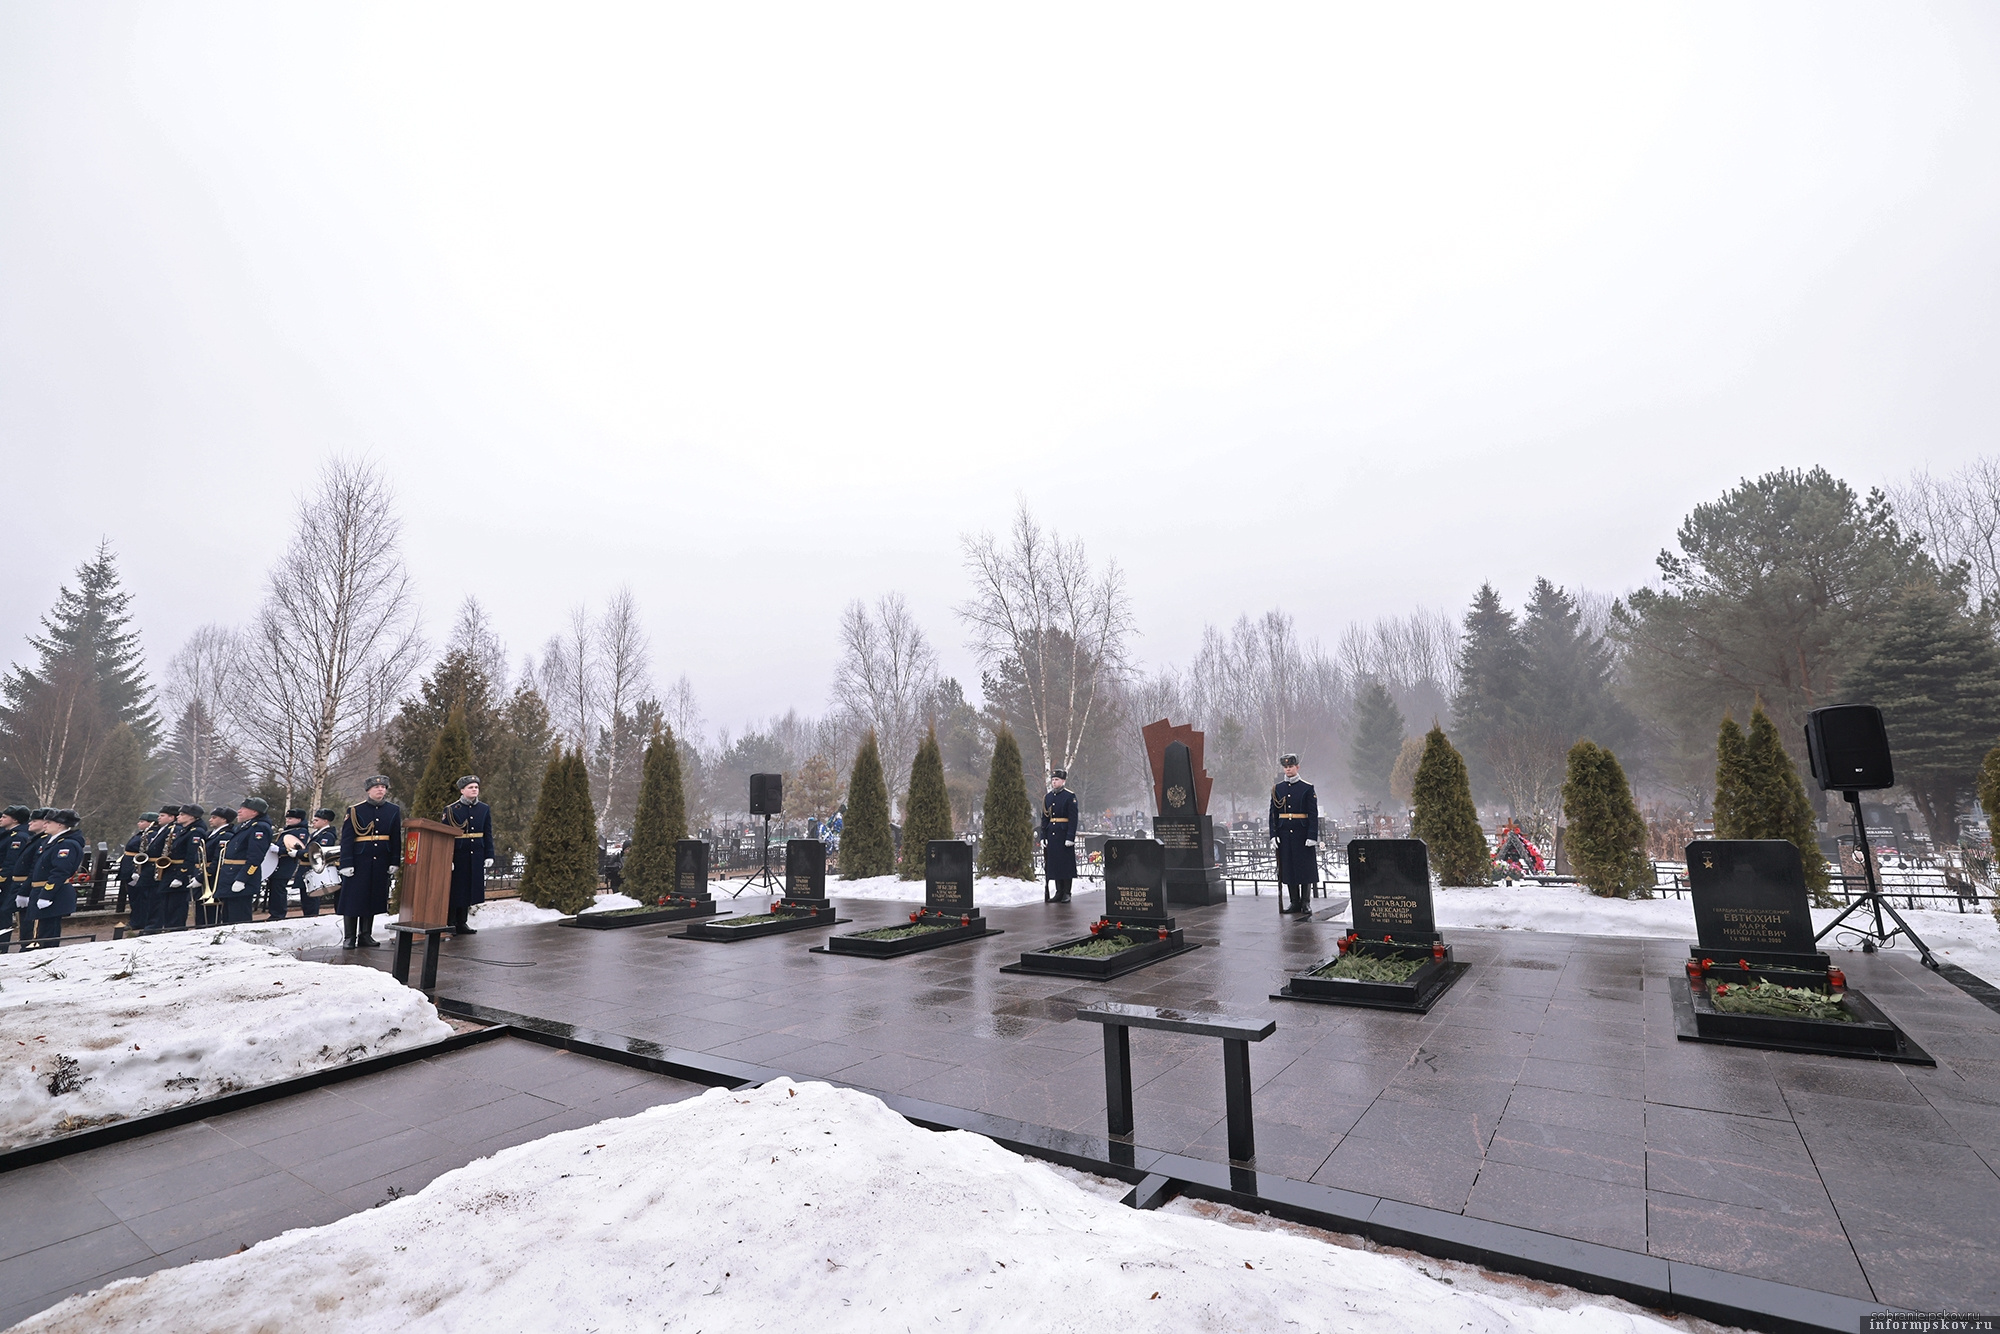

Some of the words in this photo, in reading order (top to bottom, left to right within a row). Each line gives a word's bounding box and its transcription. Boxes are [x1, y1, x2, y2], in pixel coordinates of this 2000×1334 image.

[1120, 890, 1147, 898] ШВЕЦОВ
[1363, 899, 1418, 908] ДОСТАВАЛОВ
[1371, 906, 1410, 914] АЛЕКСАНДР
[1370, 911, 1413, 919] ВАСИЛЬЕВИЧ
[1723, 913, 1782, 924] ЕВТЮХИН
[1739, 922, 1768, 930] МАРК
[1722, 928, 1787, 938] НИКОЛАЕВИЧ
